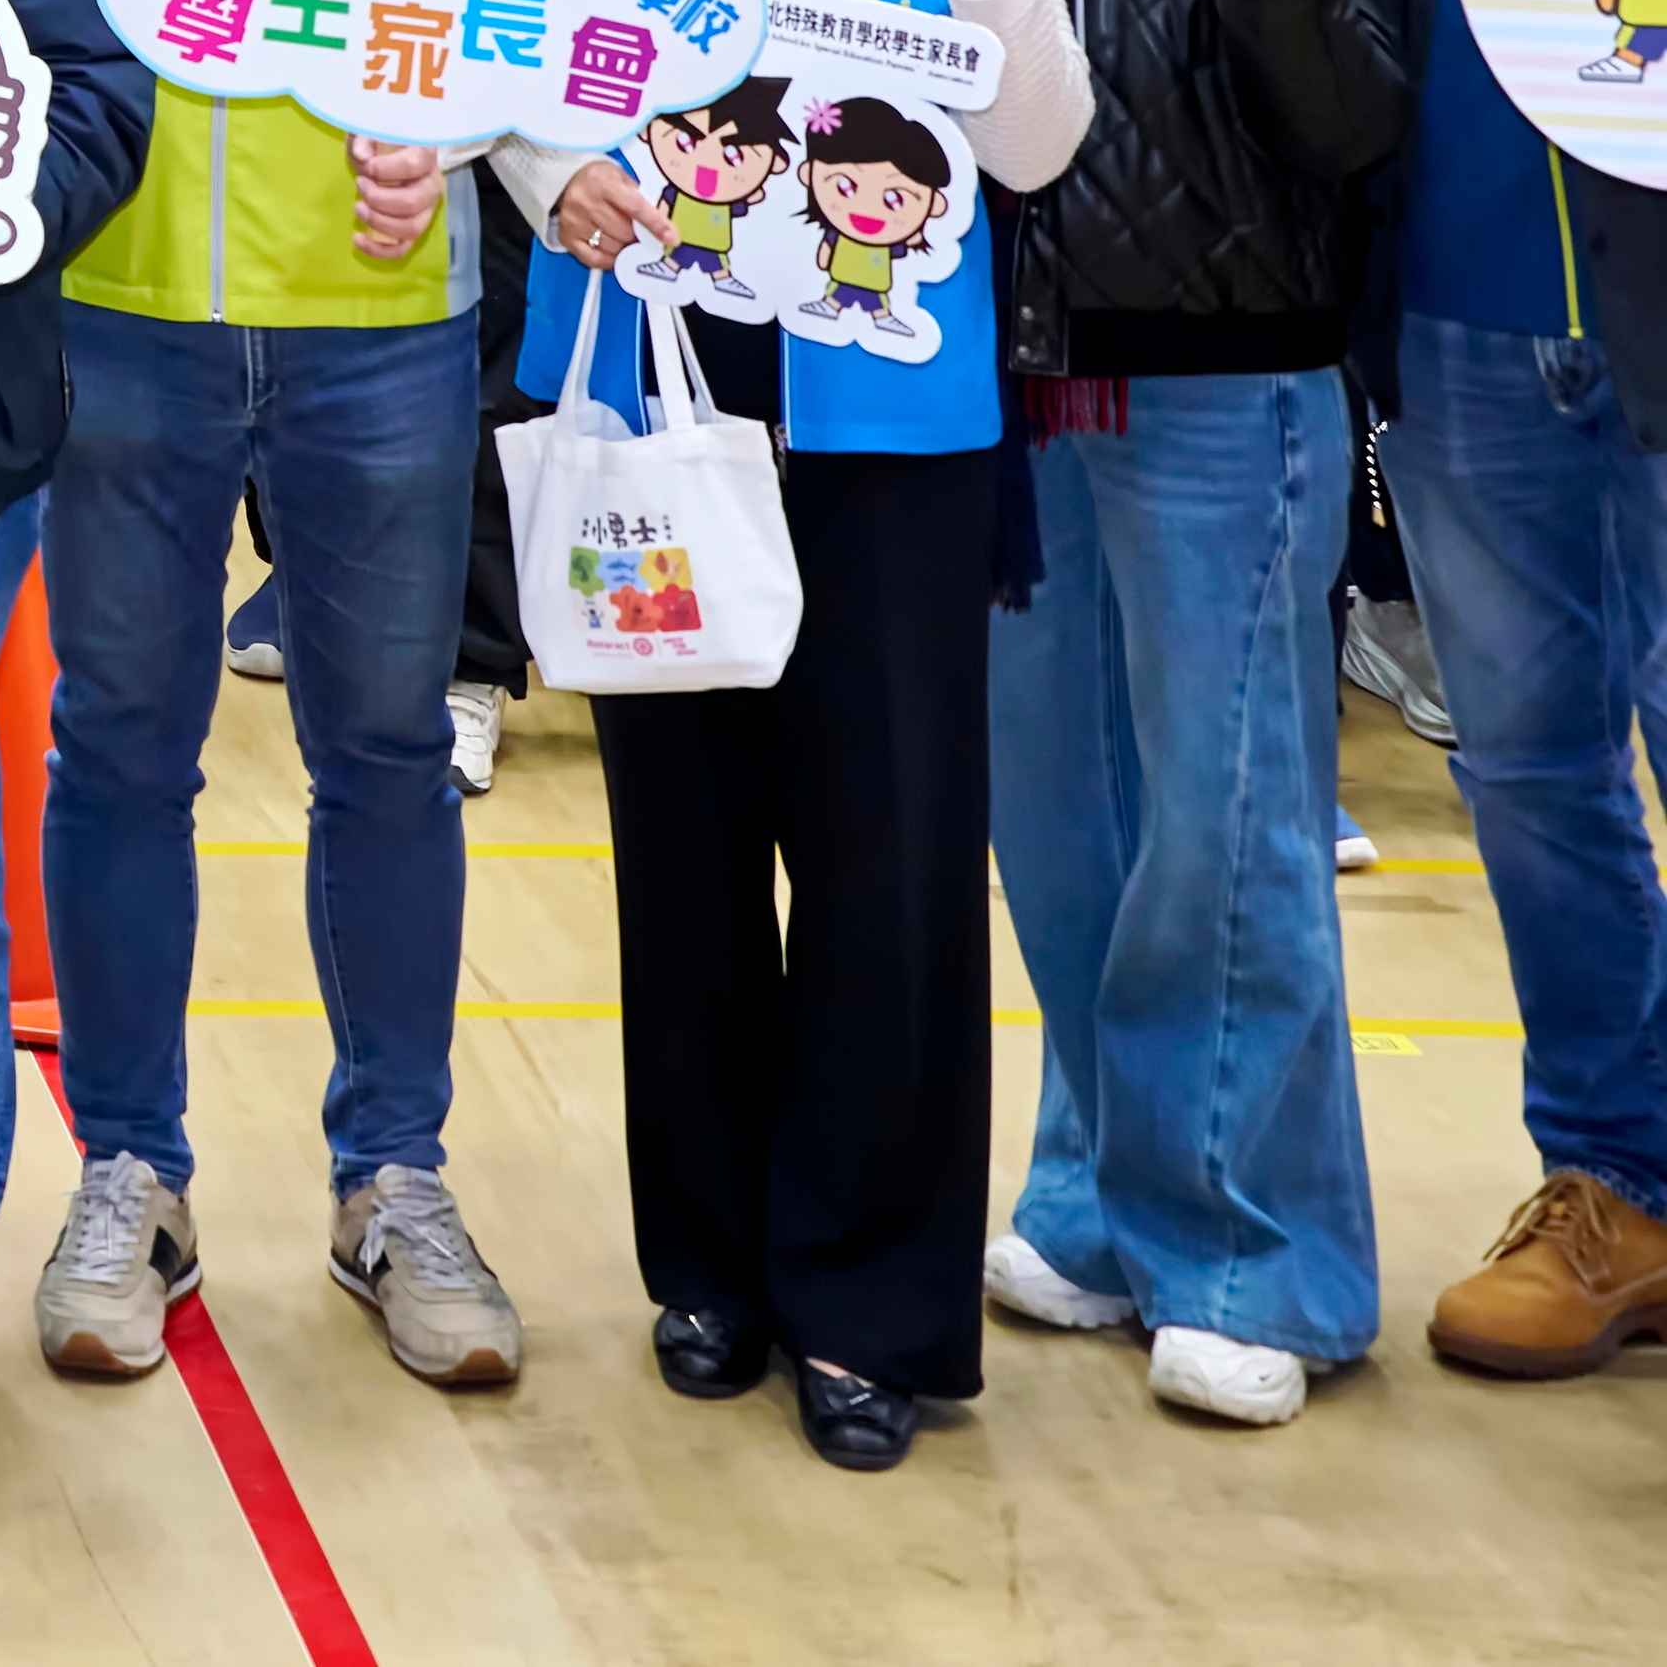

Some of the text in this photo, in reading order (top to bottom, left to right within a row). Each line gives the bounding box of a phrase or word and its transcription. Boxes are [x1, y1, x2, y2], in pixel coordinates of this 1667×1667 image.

[768, 0, 980, 74] 北特殊教育學校學生家長會
